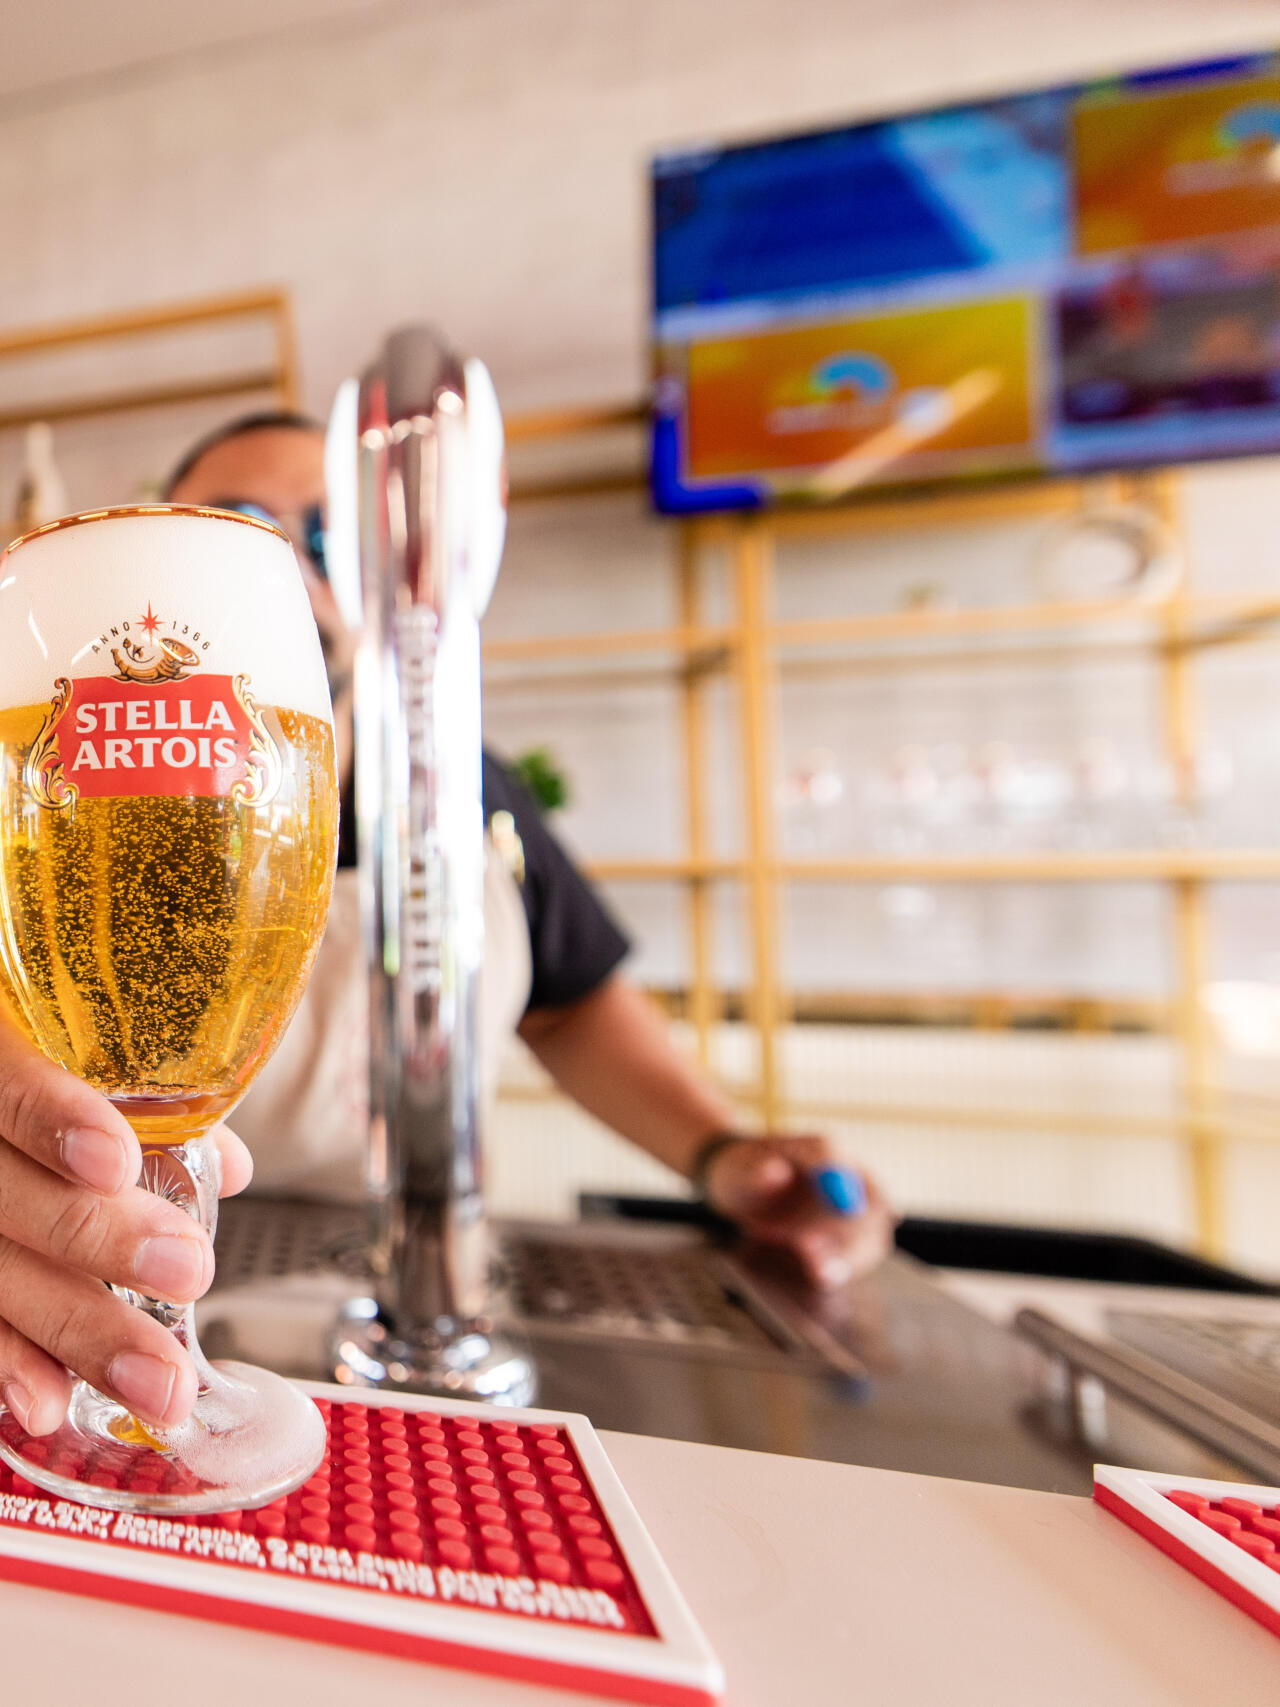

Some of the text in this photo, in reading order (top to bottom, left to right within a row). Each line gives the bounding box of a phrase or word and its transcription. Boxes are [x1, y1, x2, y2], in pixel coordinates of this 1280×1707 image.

[91, 620, 210, 654] ANNO 1366
[75, 699, 236, 734] STELLA
[71, 737, 238, 771] ARTOIS
[54, 1501, 114, 1527] Enjoy
